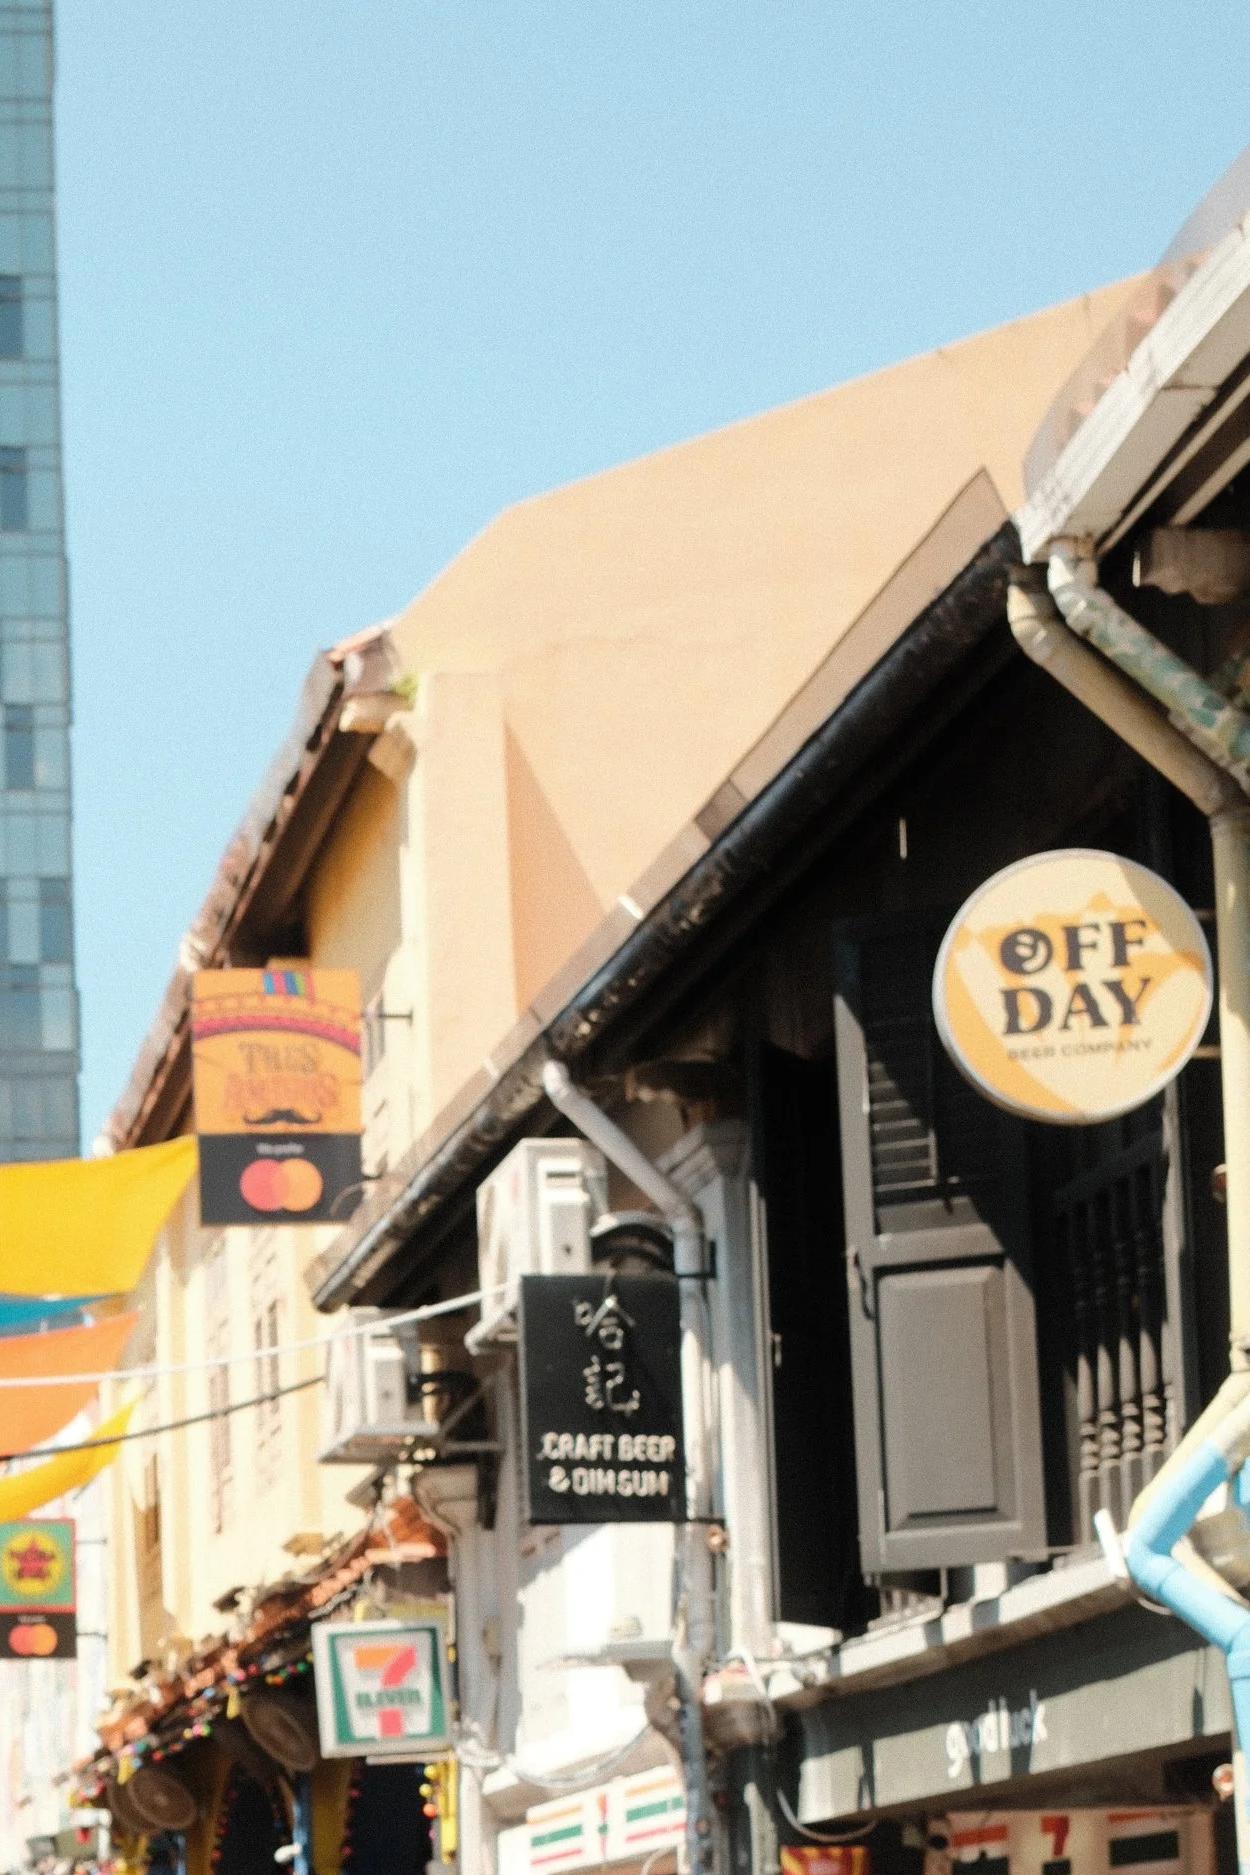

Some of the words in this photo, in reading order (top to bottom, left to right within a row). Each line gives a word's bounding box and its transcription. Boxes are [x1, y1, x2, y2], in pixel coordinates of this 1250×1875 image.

[1000, 918, 1147, 977] OFF
[1000, 976, 1151, 1036] DAY
[542, 1431, 615, 1461] CRAFT
[617, 1433, 676, 1463] BEER
